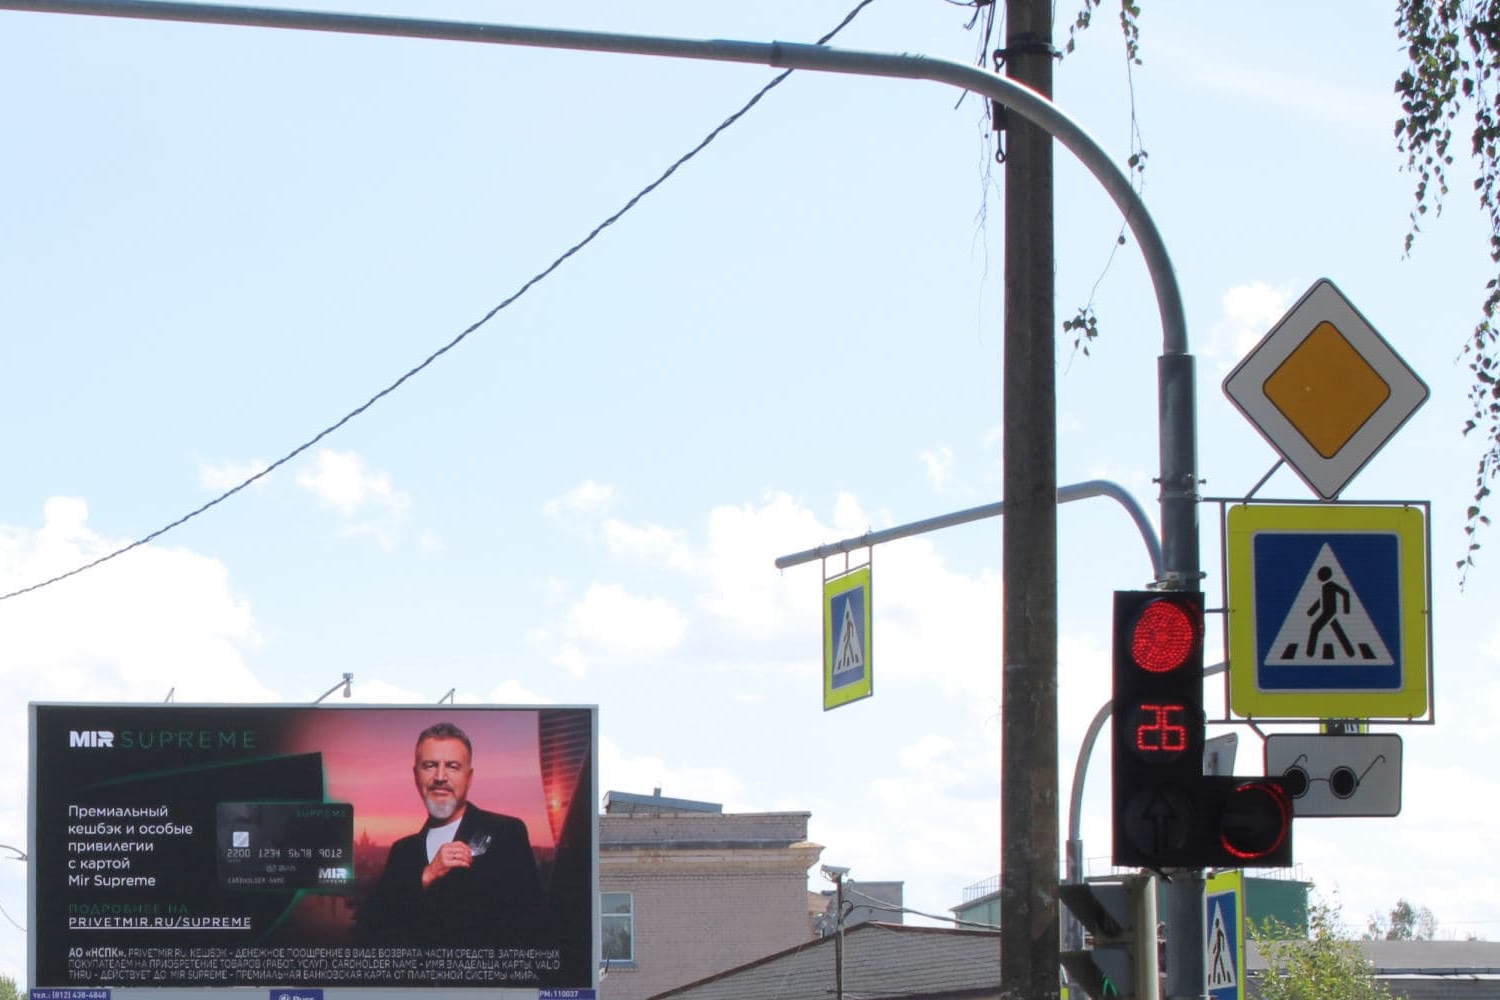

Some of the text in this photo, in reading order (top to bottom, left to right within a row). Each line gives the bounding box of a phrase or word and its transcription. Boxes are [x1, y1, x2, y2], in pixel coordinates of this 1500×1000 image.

[69, 730, 256, 748] MIR SUPREME
[68, 804, 168, 819] Премиальный
[68, 823, 193, 834] кешбэк и особые
[68, 842, 154, 854] привилегии
[227, 848, 251, 858] 2200
[258, 848, 281, 858] 1234
[319, 848, 343, 858] 9012
[68, 857, 130, 871] с картой
[318, 868, 348, 879] MIR
[68, 875, 156, 888] Mir Supreme
[68, 917, 252, 928] PRIVETMIR.RU/SUPREME
[68, 948, 83, 958] АО
[85, 948, 127, 958] «НСПК».
